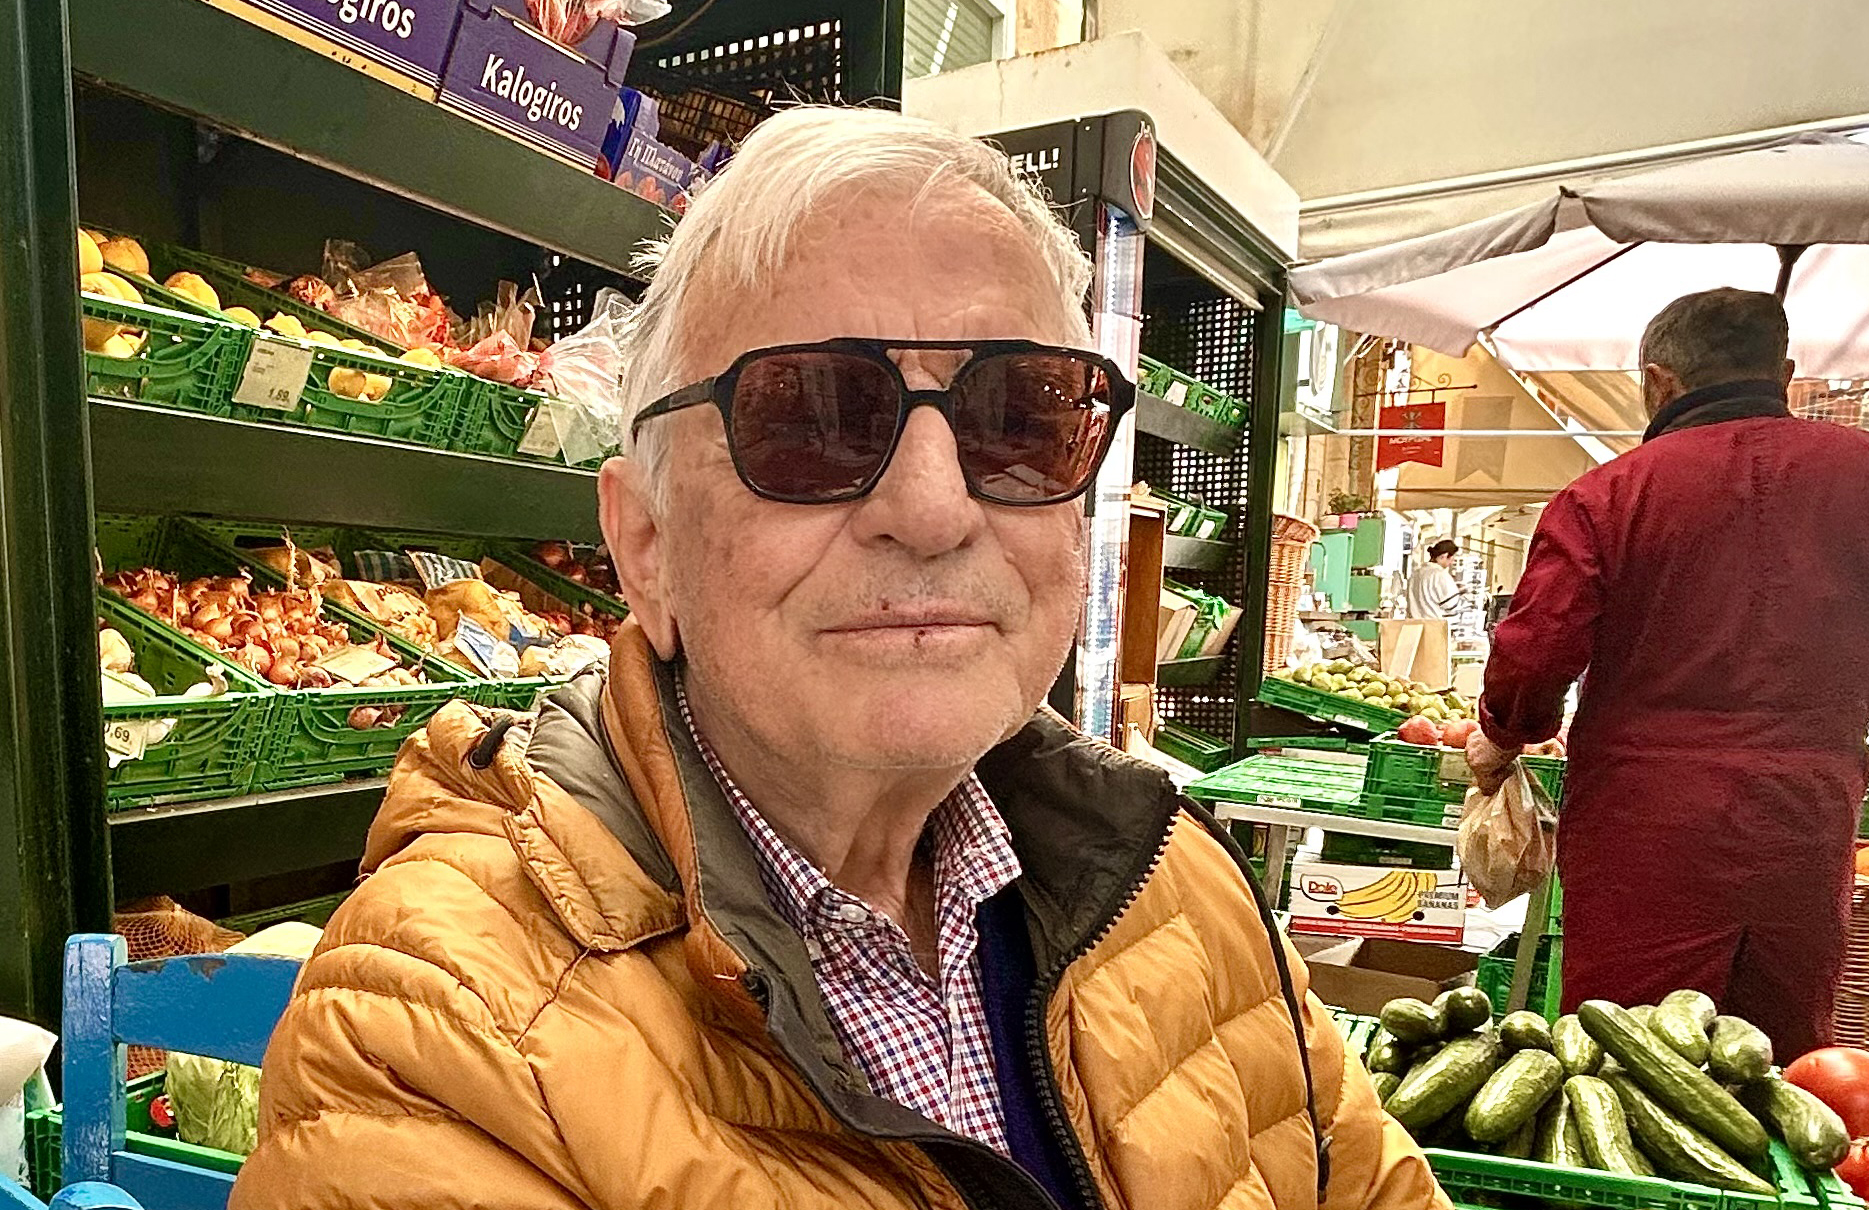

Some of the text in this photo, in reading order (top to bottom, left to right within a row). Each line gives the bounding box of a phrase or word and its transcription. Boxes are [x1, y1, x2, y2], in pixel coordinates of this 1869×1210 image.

[327, 0, 416, 39] giros
[480, 53, 583, 131] Kalogiros
[1308, 880, 1338, 895] Dole
